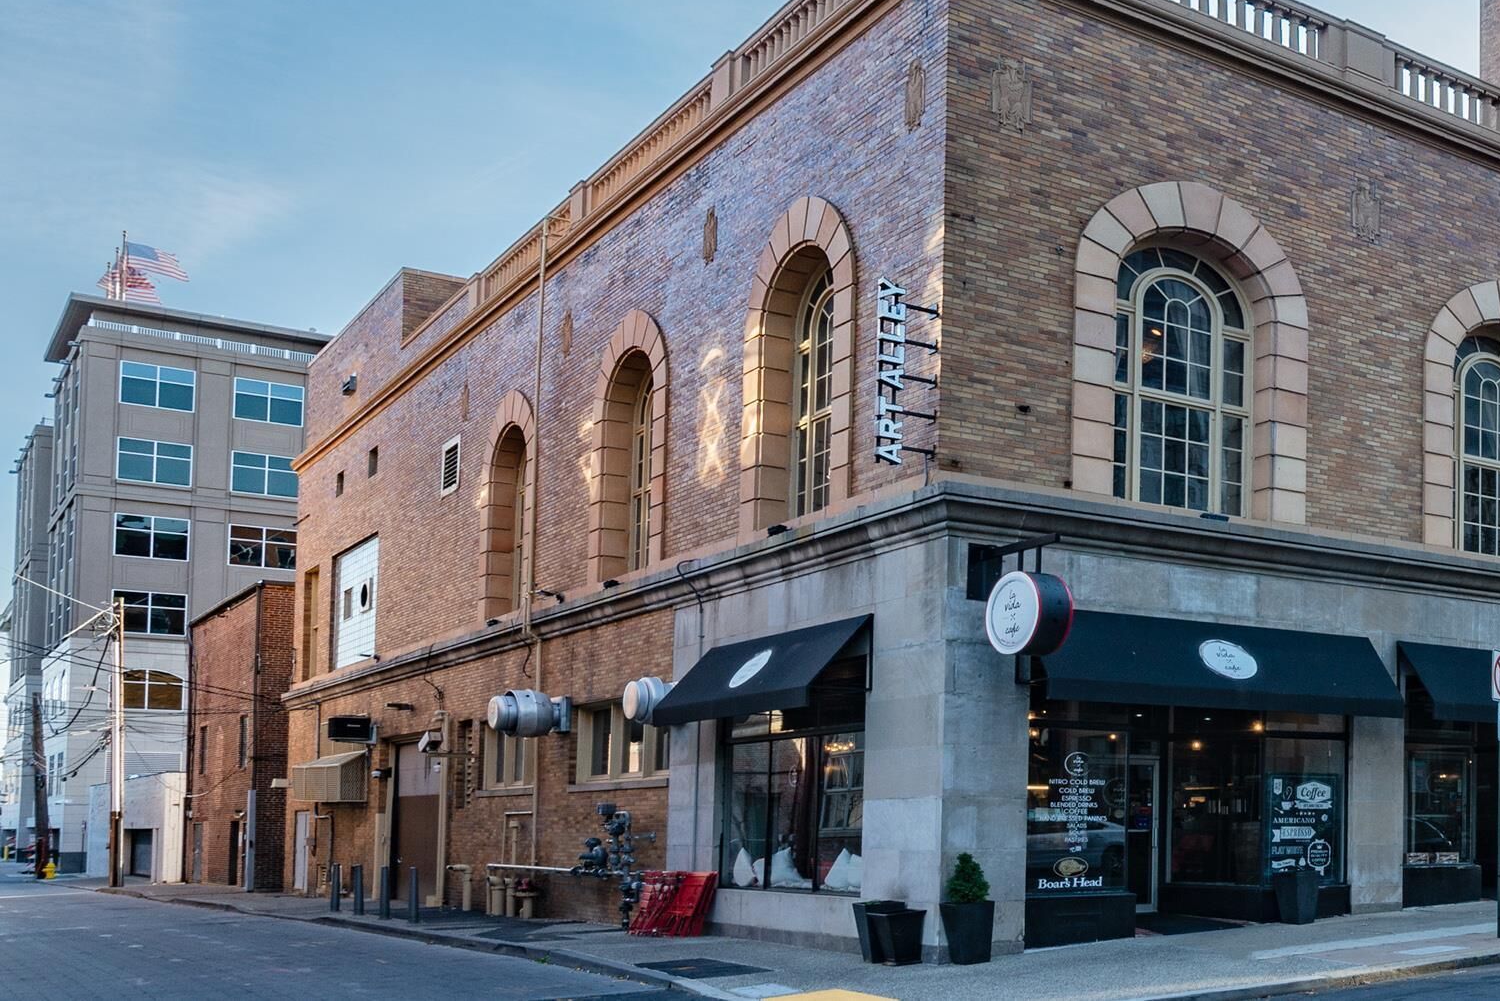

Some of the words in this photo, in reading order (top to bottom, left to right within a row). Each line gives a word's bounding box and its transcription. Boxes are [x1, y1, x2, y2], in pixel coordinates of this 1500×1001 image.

[877, 276, 907, 389] ALLEY
[875, 395, 904, 466] ART
[1301, 786, 1327, 800] Coffee
[1282, 827, 1312, 836] ESPRESSO
[1072, 876, 1103, 888] Head
